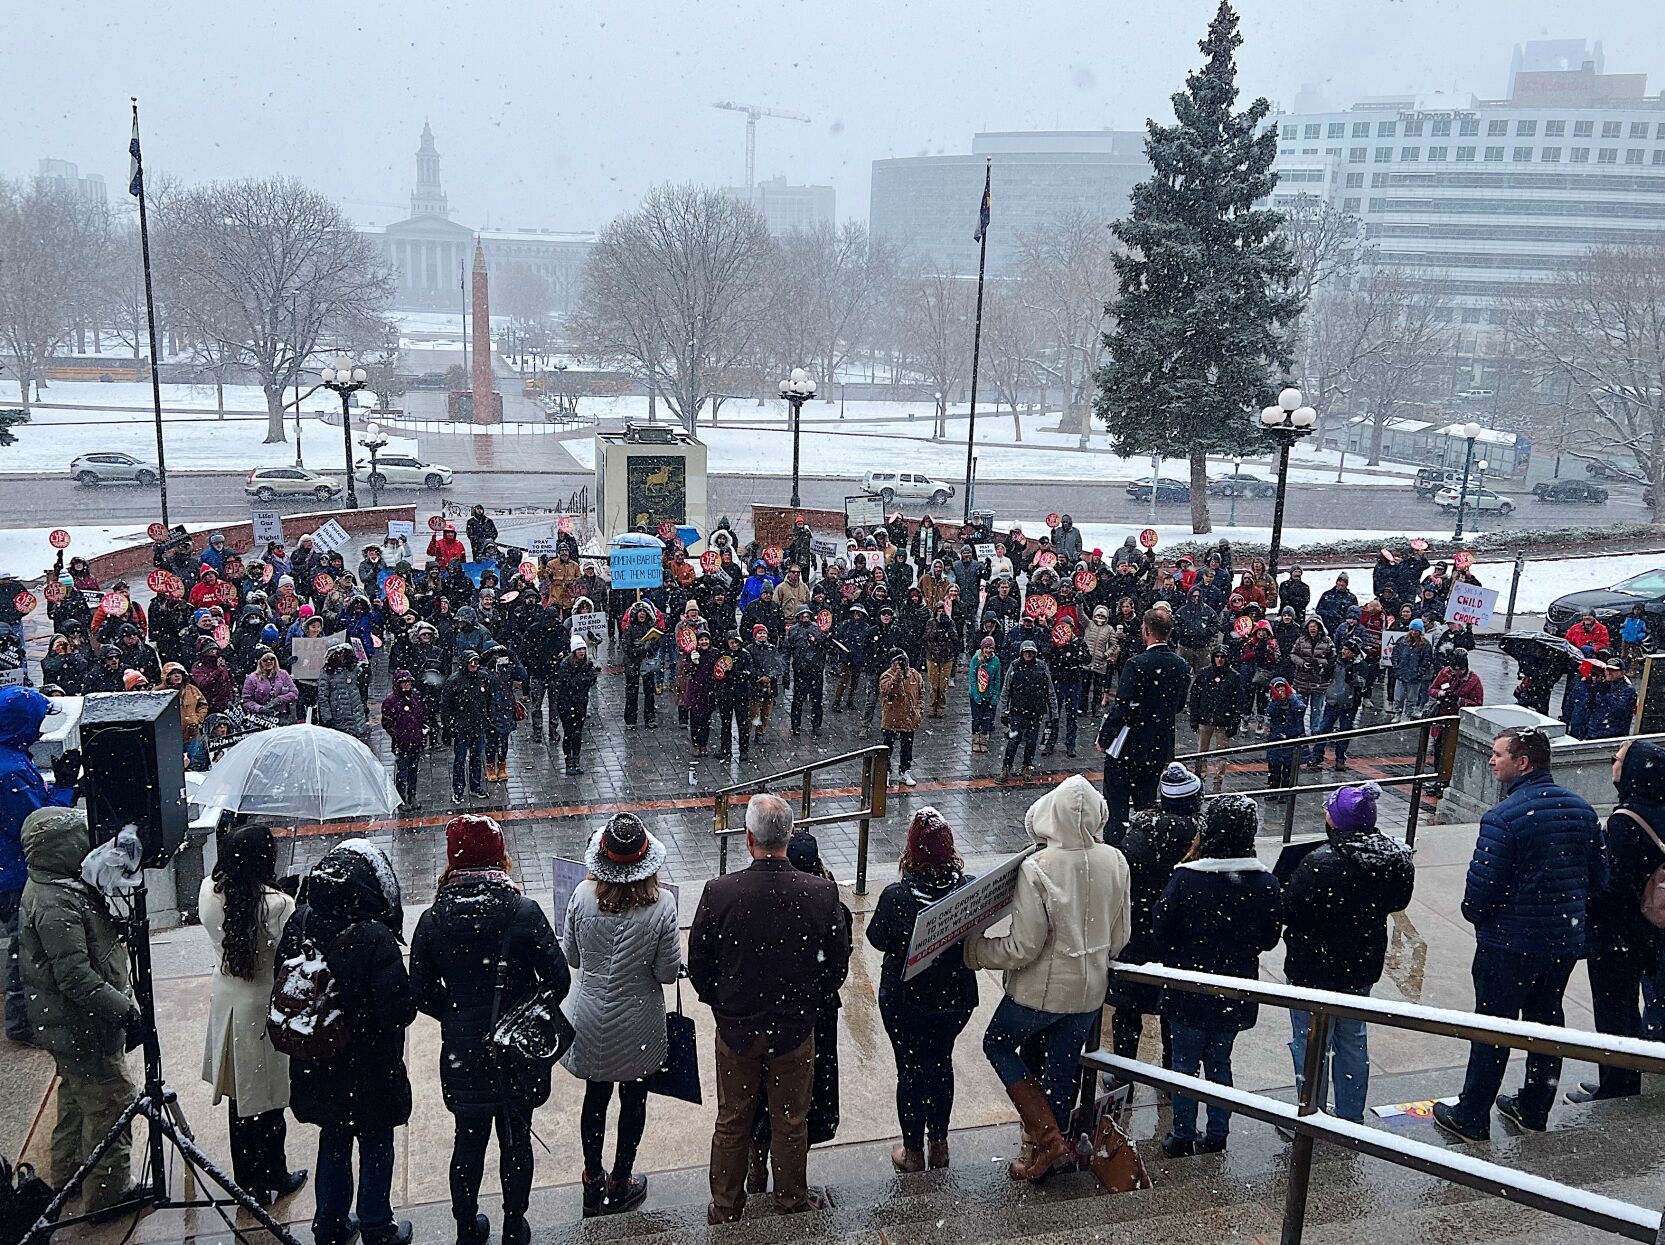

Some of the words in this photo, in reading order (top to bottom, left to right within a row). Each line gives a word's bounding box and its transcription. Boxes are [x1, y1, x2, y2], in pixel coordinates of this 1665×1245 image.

[702, 556, 722, 566] LIFE
[216, 588, 236, 597] LIFE
[103, 600, 128, 609] LIFE
[1458, 596, 1482, 608] CHILD
[1453, 612, 1480, 625] CHOICE
[574, 624, 606, 632] ABORTION
[1053, 626, 1070, 642] LIFE
[926, 916, 937, 928] NO
[939, 907, 954, 920] ONE
[955, 891, 979, 910] GROWS
[981, 883, 991, 894] UP
[928, 924, 937, 934] TO
[938, 913, 959, 930] WORK
[960, 906, 968, 916] IN
